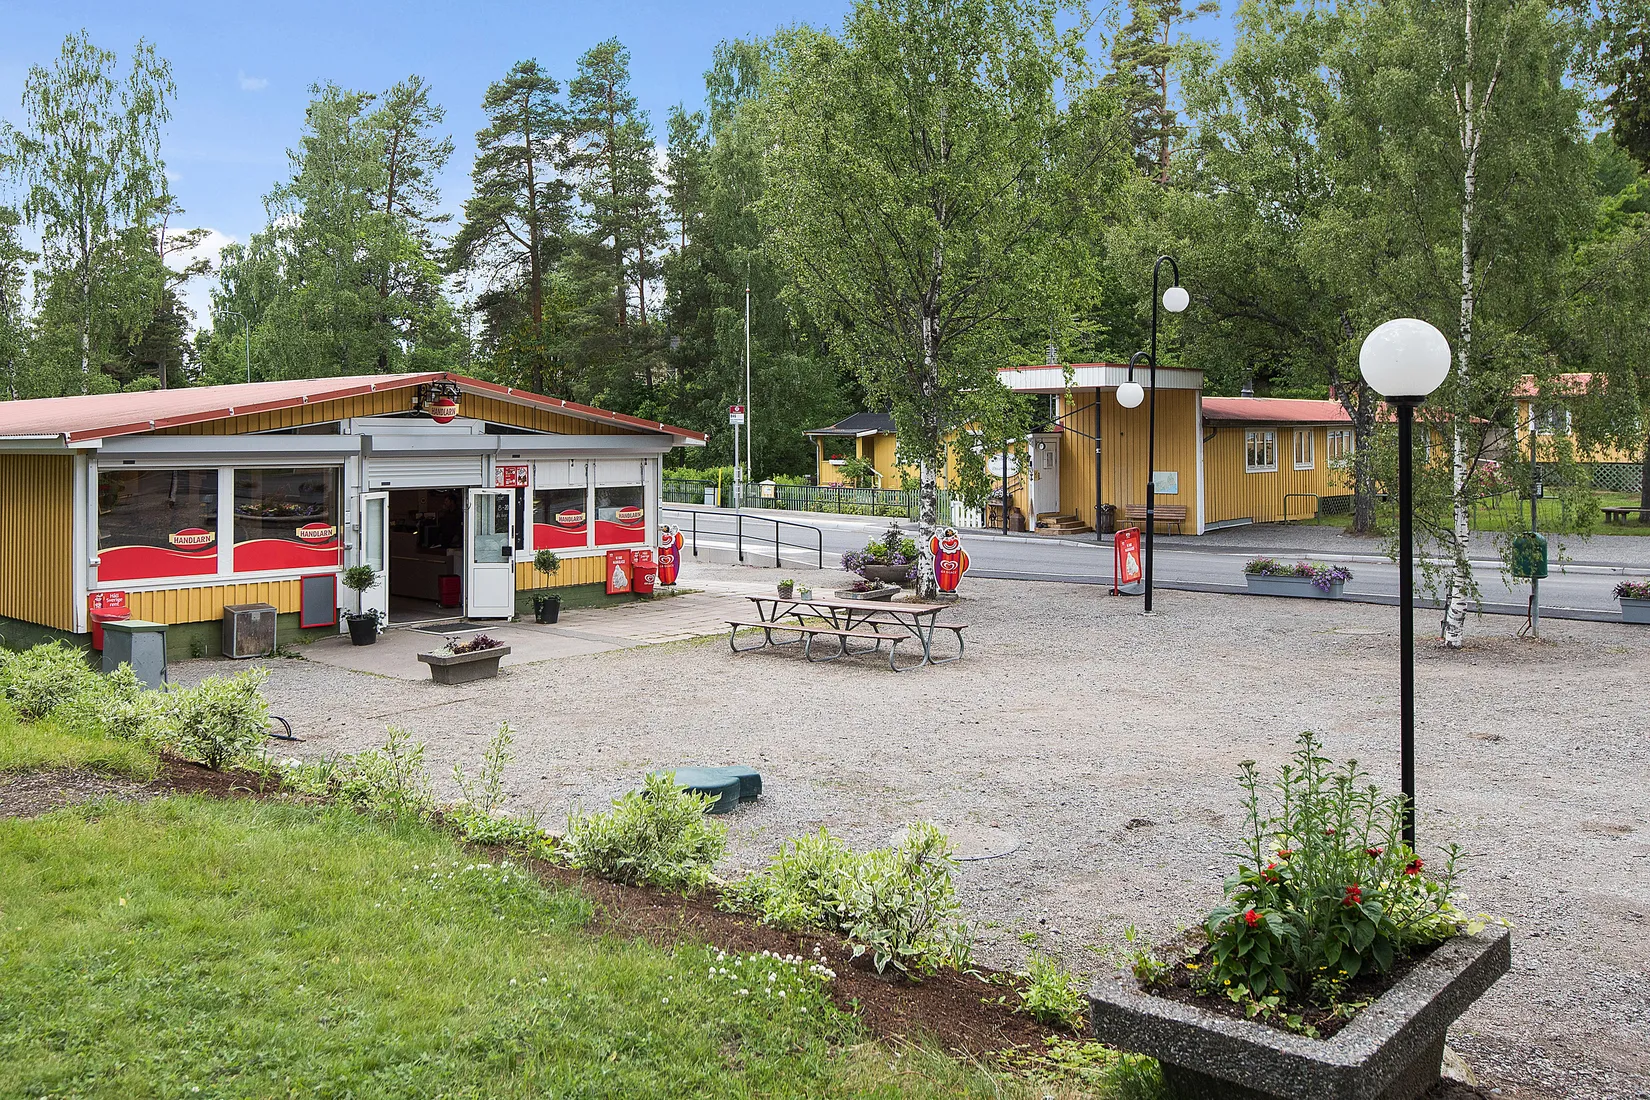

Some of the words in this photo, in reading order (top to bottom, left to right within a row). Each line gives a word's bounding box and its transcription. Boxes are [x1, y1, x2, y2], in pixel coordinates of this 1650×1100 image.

[431, 406, 456, 416] HANDLARN
[558, 515, 583, 523] HANDLARN
[618, 511, 641, 519] HANDLARN
[300, 528, 333, 538] HANDLARN
[173, 535, 211, 544] HANDLARN
